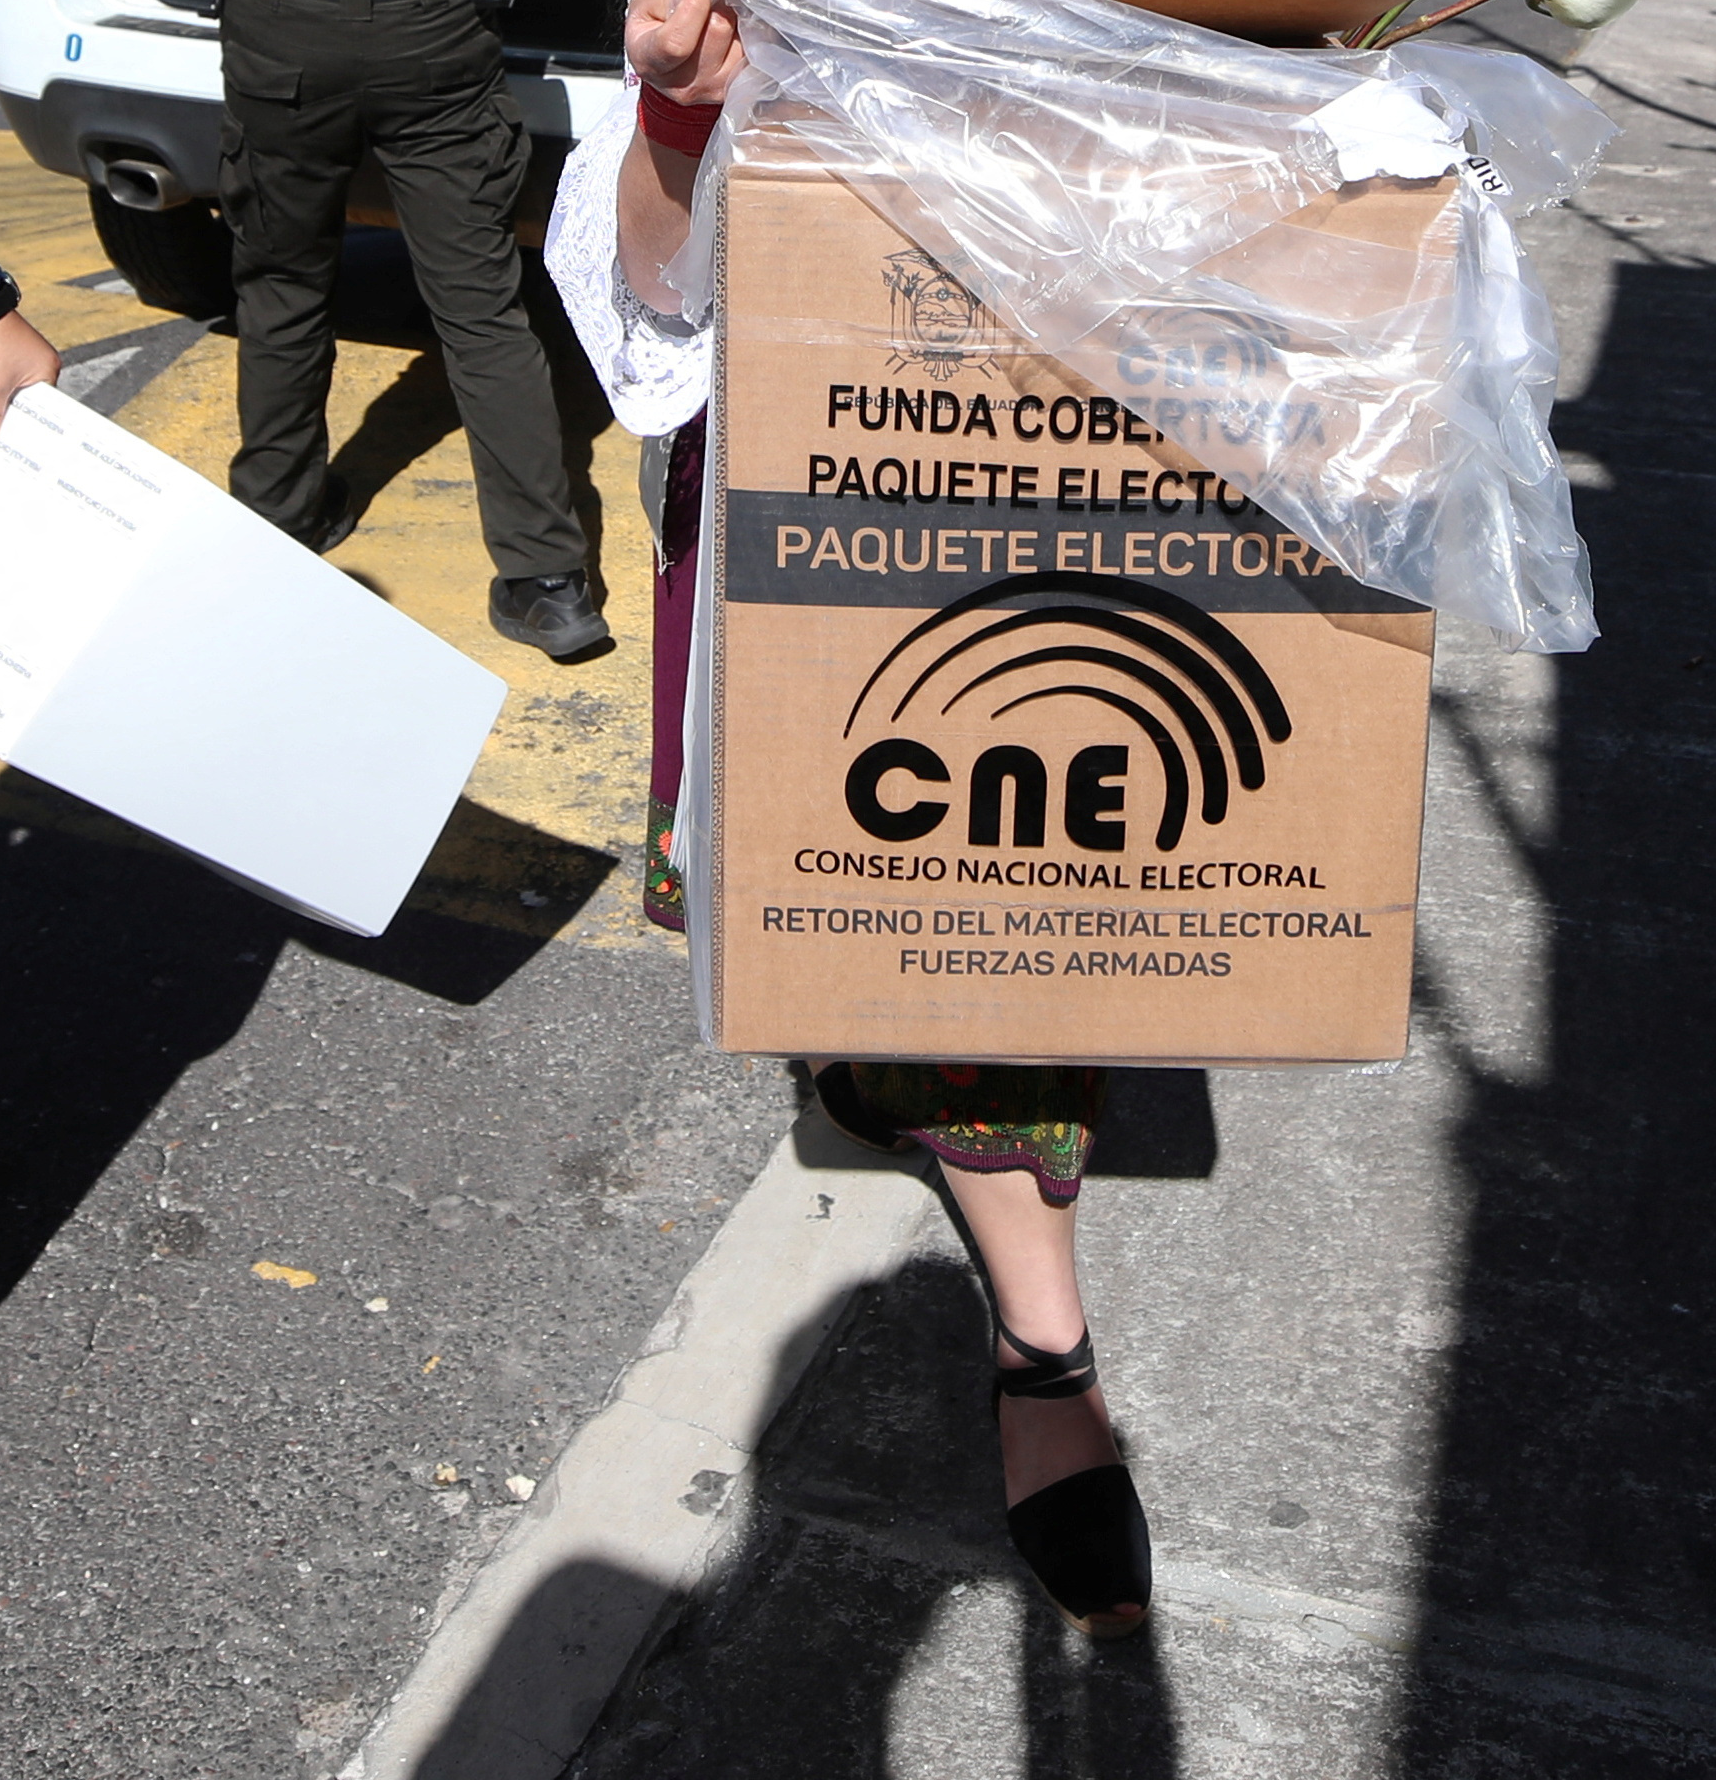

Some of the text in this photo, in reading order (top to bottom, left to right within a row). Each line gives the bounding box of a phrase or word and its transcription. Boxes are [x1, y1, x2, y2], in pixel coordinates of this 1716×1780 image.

[828, 384, 998, 440] FUNDA
[808, 454, 1040, 510] PAQUETE
[774, 524, 1351, 578] PAQUETE ELECTORA
[794, 847, 1327, 890] CONSEJO NACIONAL ELECTORAL
[762, 906, 1373, 939] RETORNO DEL MATERIAL ELECTORAL
[899, 948, 1233, 978] FUERZAS ARMADAS
